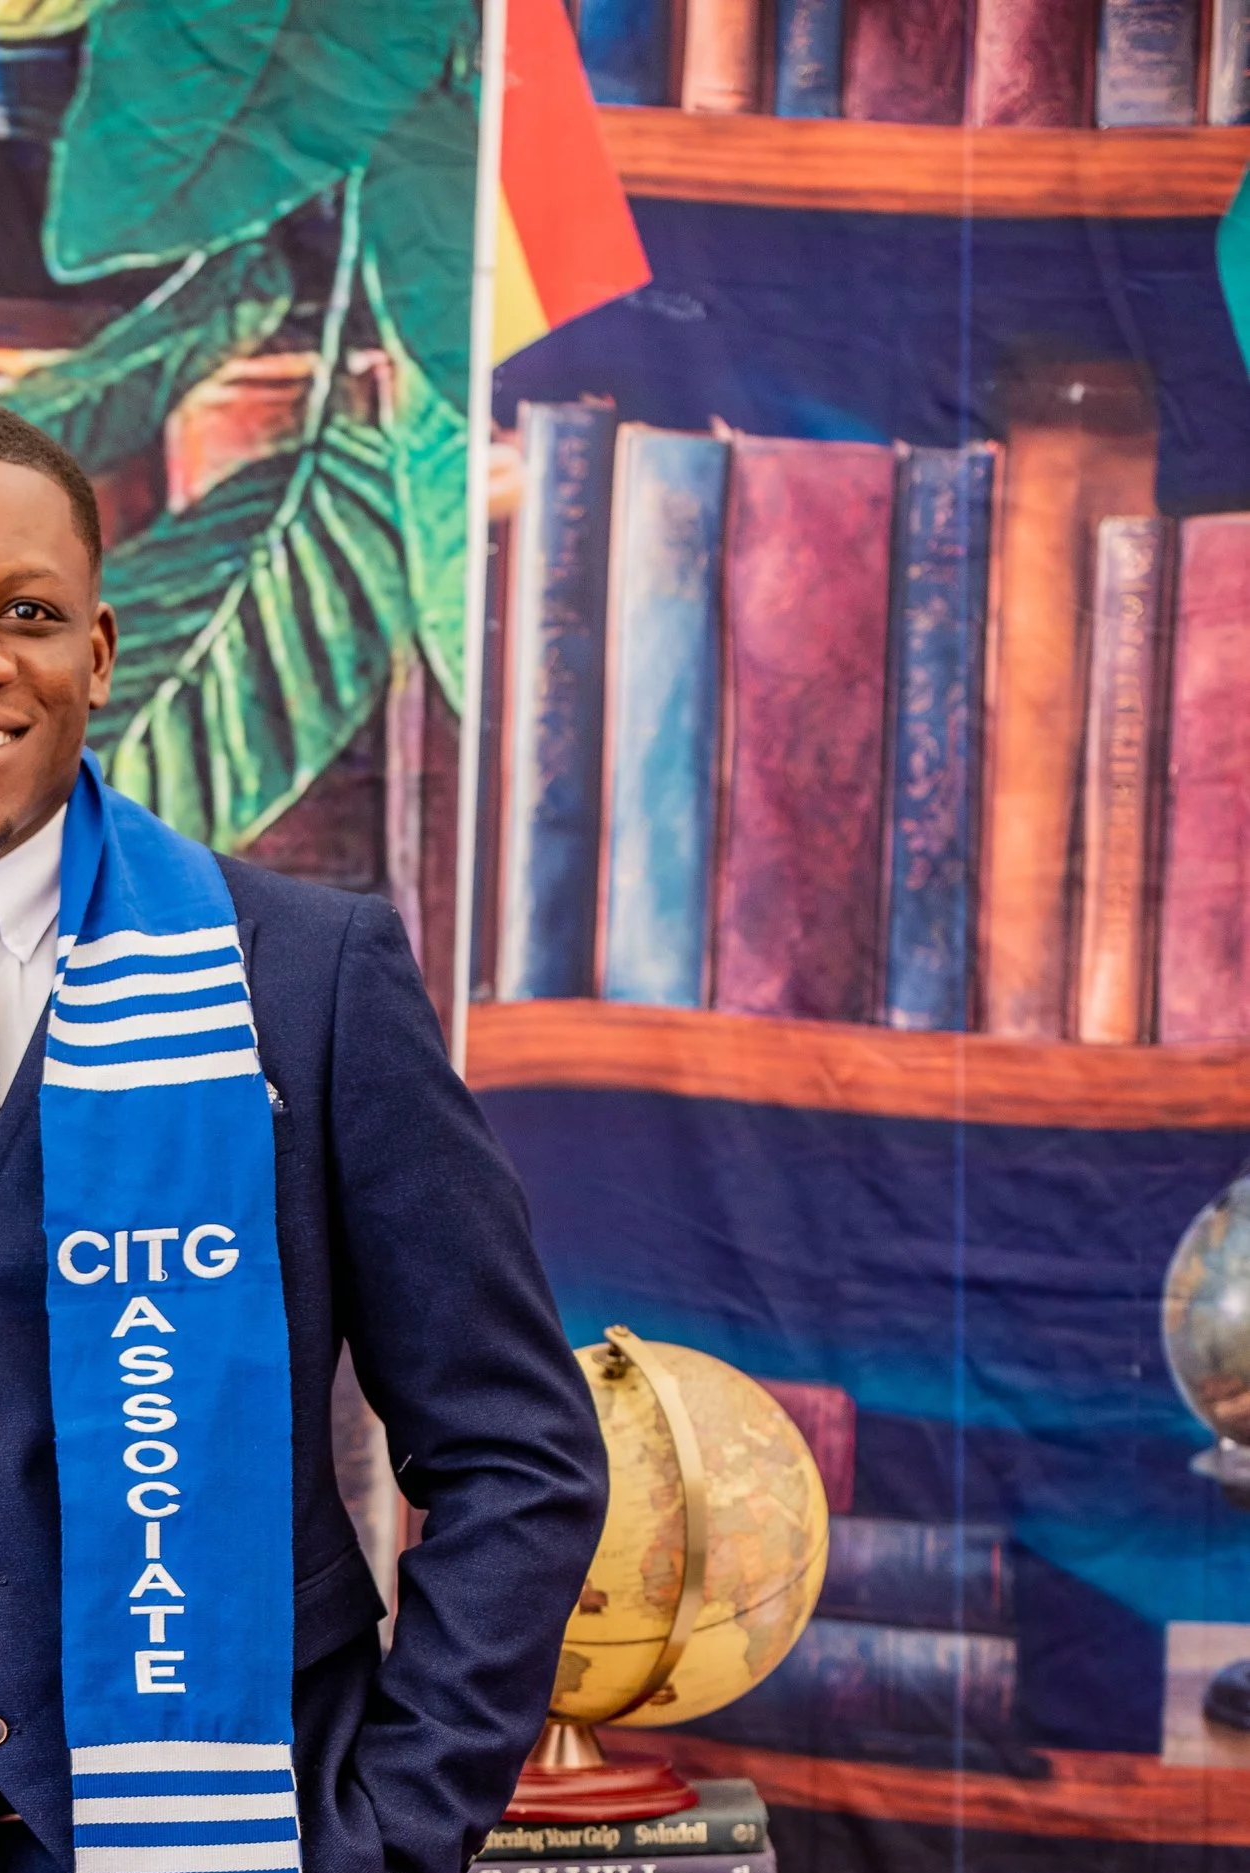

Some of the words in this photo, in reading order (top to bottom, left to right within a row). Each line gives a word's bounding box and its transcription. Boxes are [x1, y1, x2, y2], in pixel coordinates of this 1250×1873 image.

[57, 1224, 240, 1285] CITG
[111, 1296, 187, 1694] ASSOCIATE
[545, 1828, 583, 1849] Your
[583, 1825, 620, 1851] Grip
[635, 1821, 708, 1846] Swindoll
